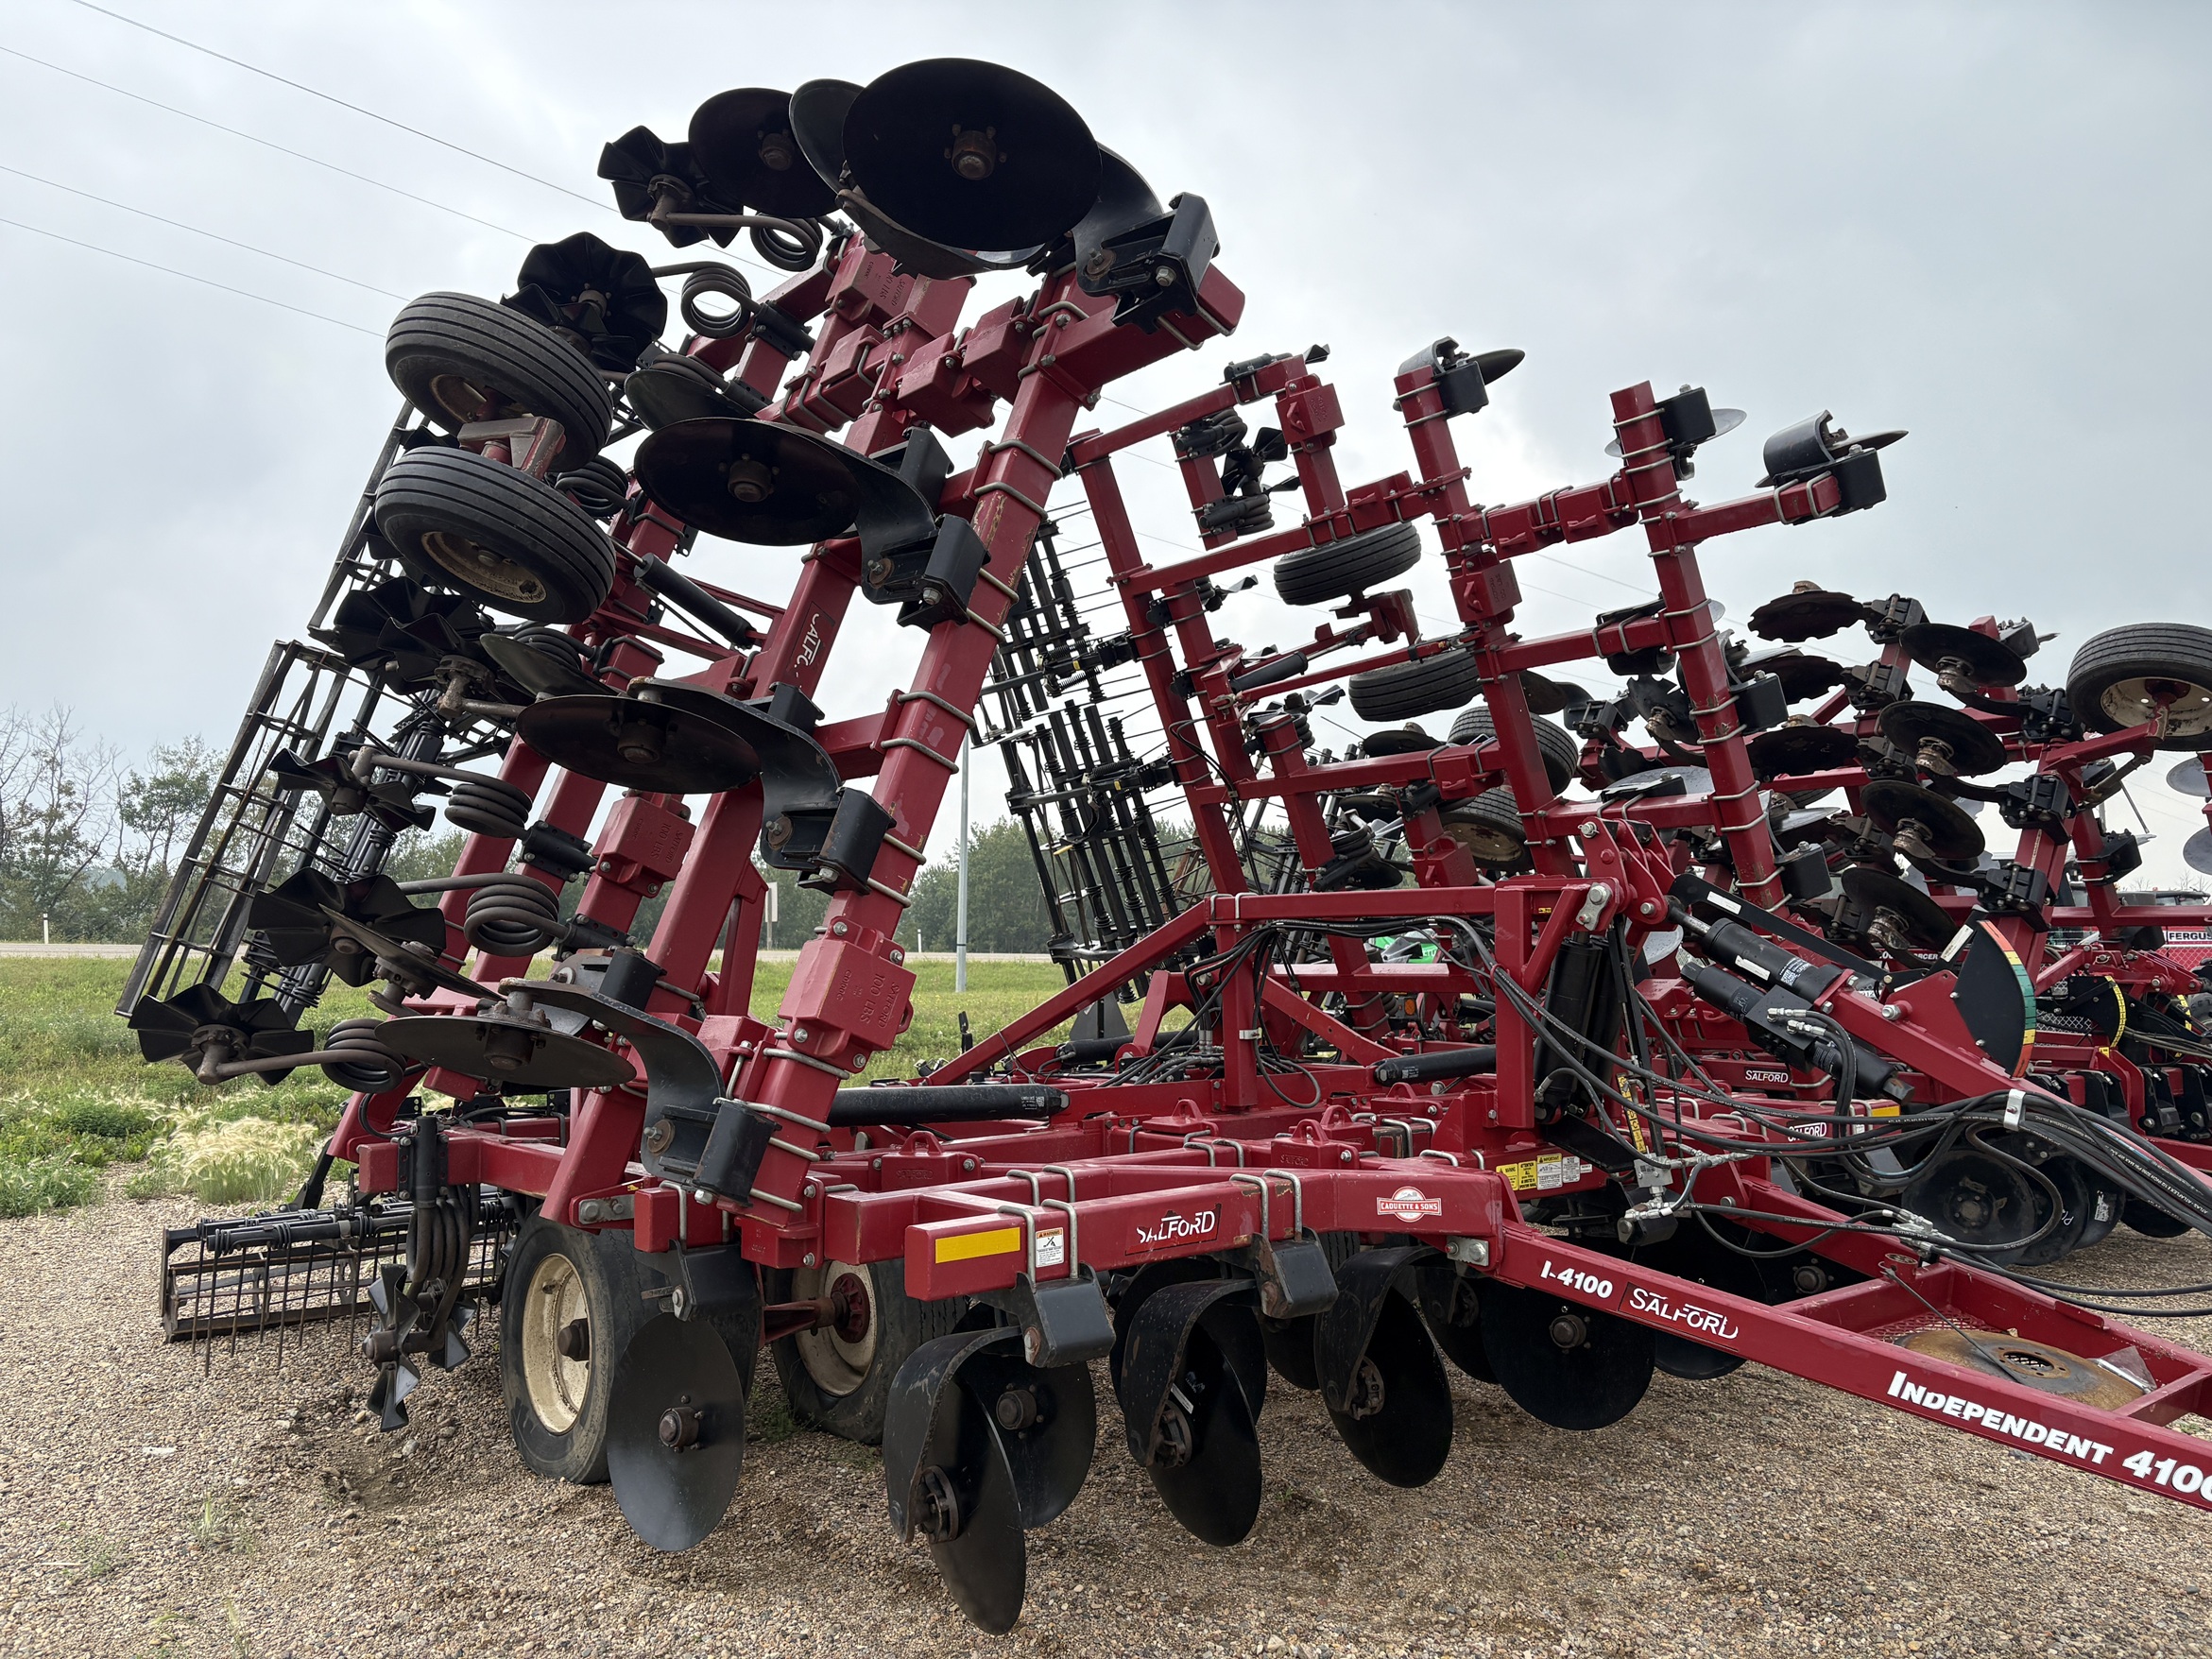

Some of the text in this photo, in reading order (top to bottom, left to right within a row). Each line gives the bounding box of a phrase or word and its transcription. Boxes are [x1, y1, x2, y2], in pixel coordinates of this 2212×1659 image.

[860, 973, 886, 1024] 100 LBS
[1745, 1069, 1789, 1084] SALFORD
[1380, 1202, 1414, 1210] CAOUETTE
[1539, 1260, 1613, 1299] I-4100
[1629, 1288, 1739, 1340] SALFORD
